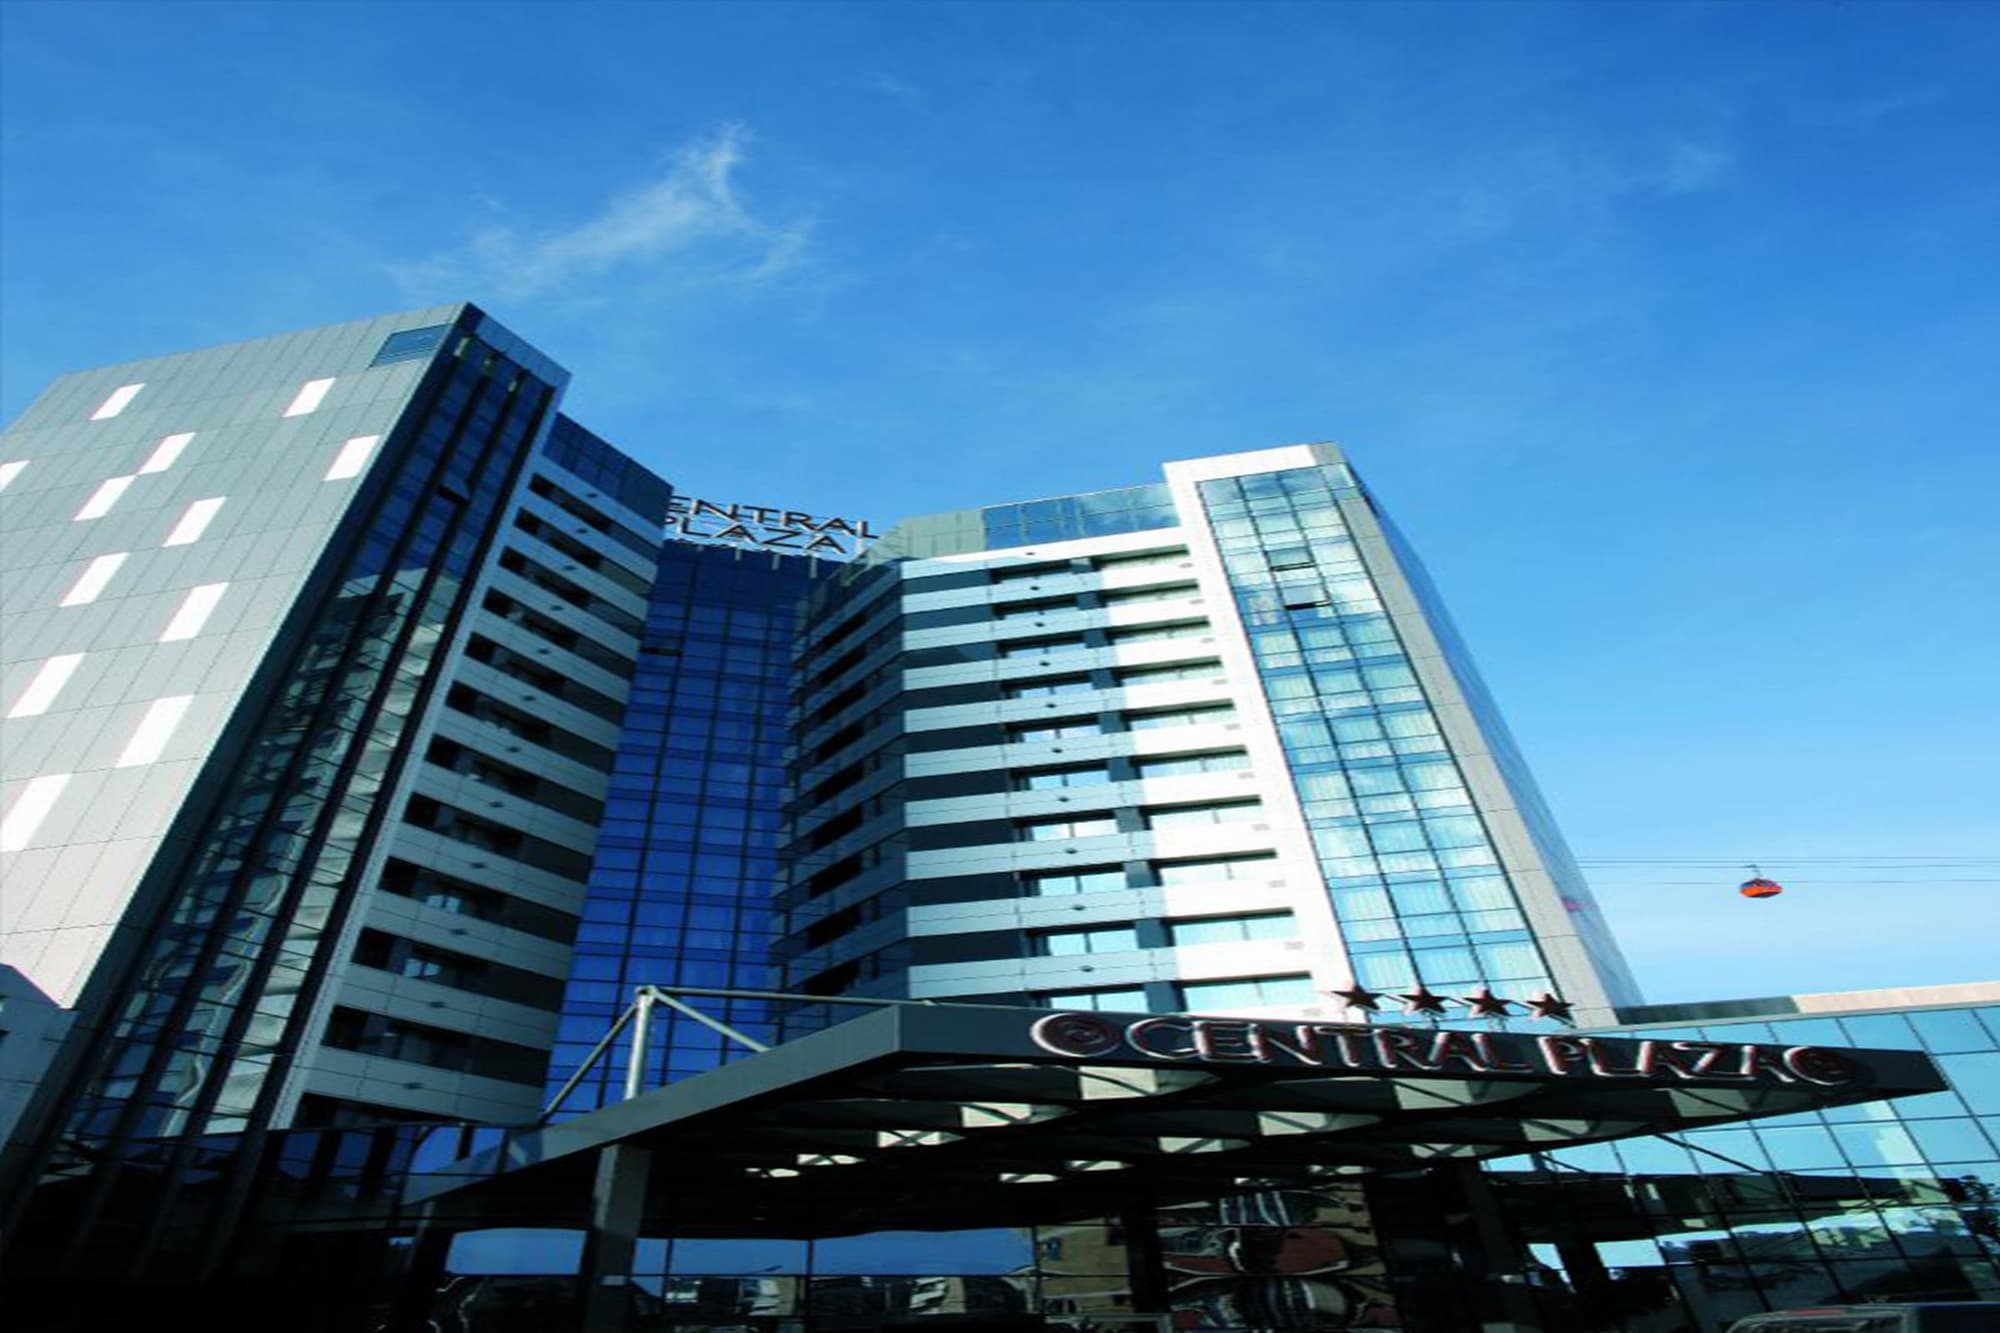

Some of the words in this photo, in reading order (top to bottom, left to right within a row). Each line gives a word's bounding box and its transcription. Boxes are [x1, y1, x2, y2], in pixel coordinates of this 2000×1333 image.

[668, 496, 879, 539] ENTRAL
[1125, 1015, 1532, 1073] CENTRAL
[1537, 1035, 1796, 1084] PLAZA
